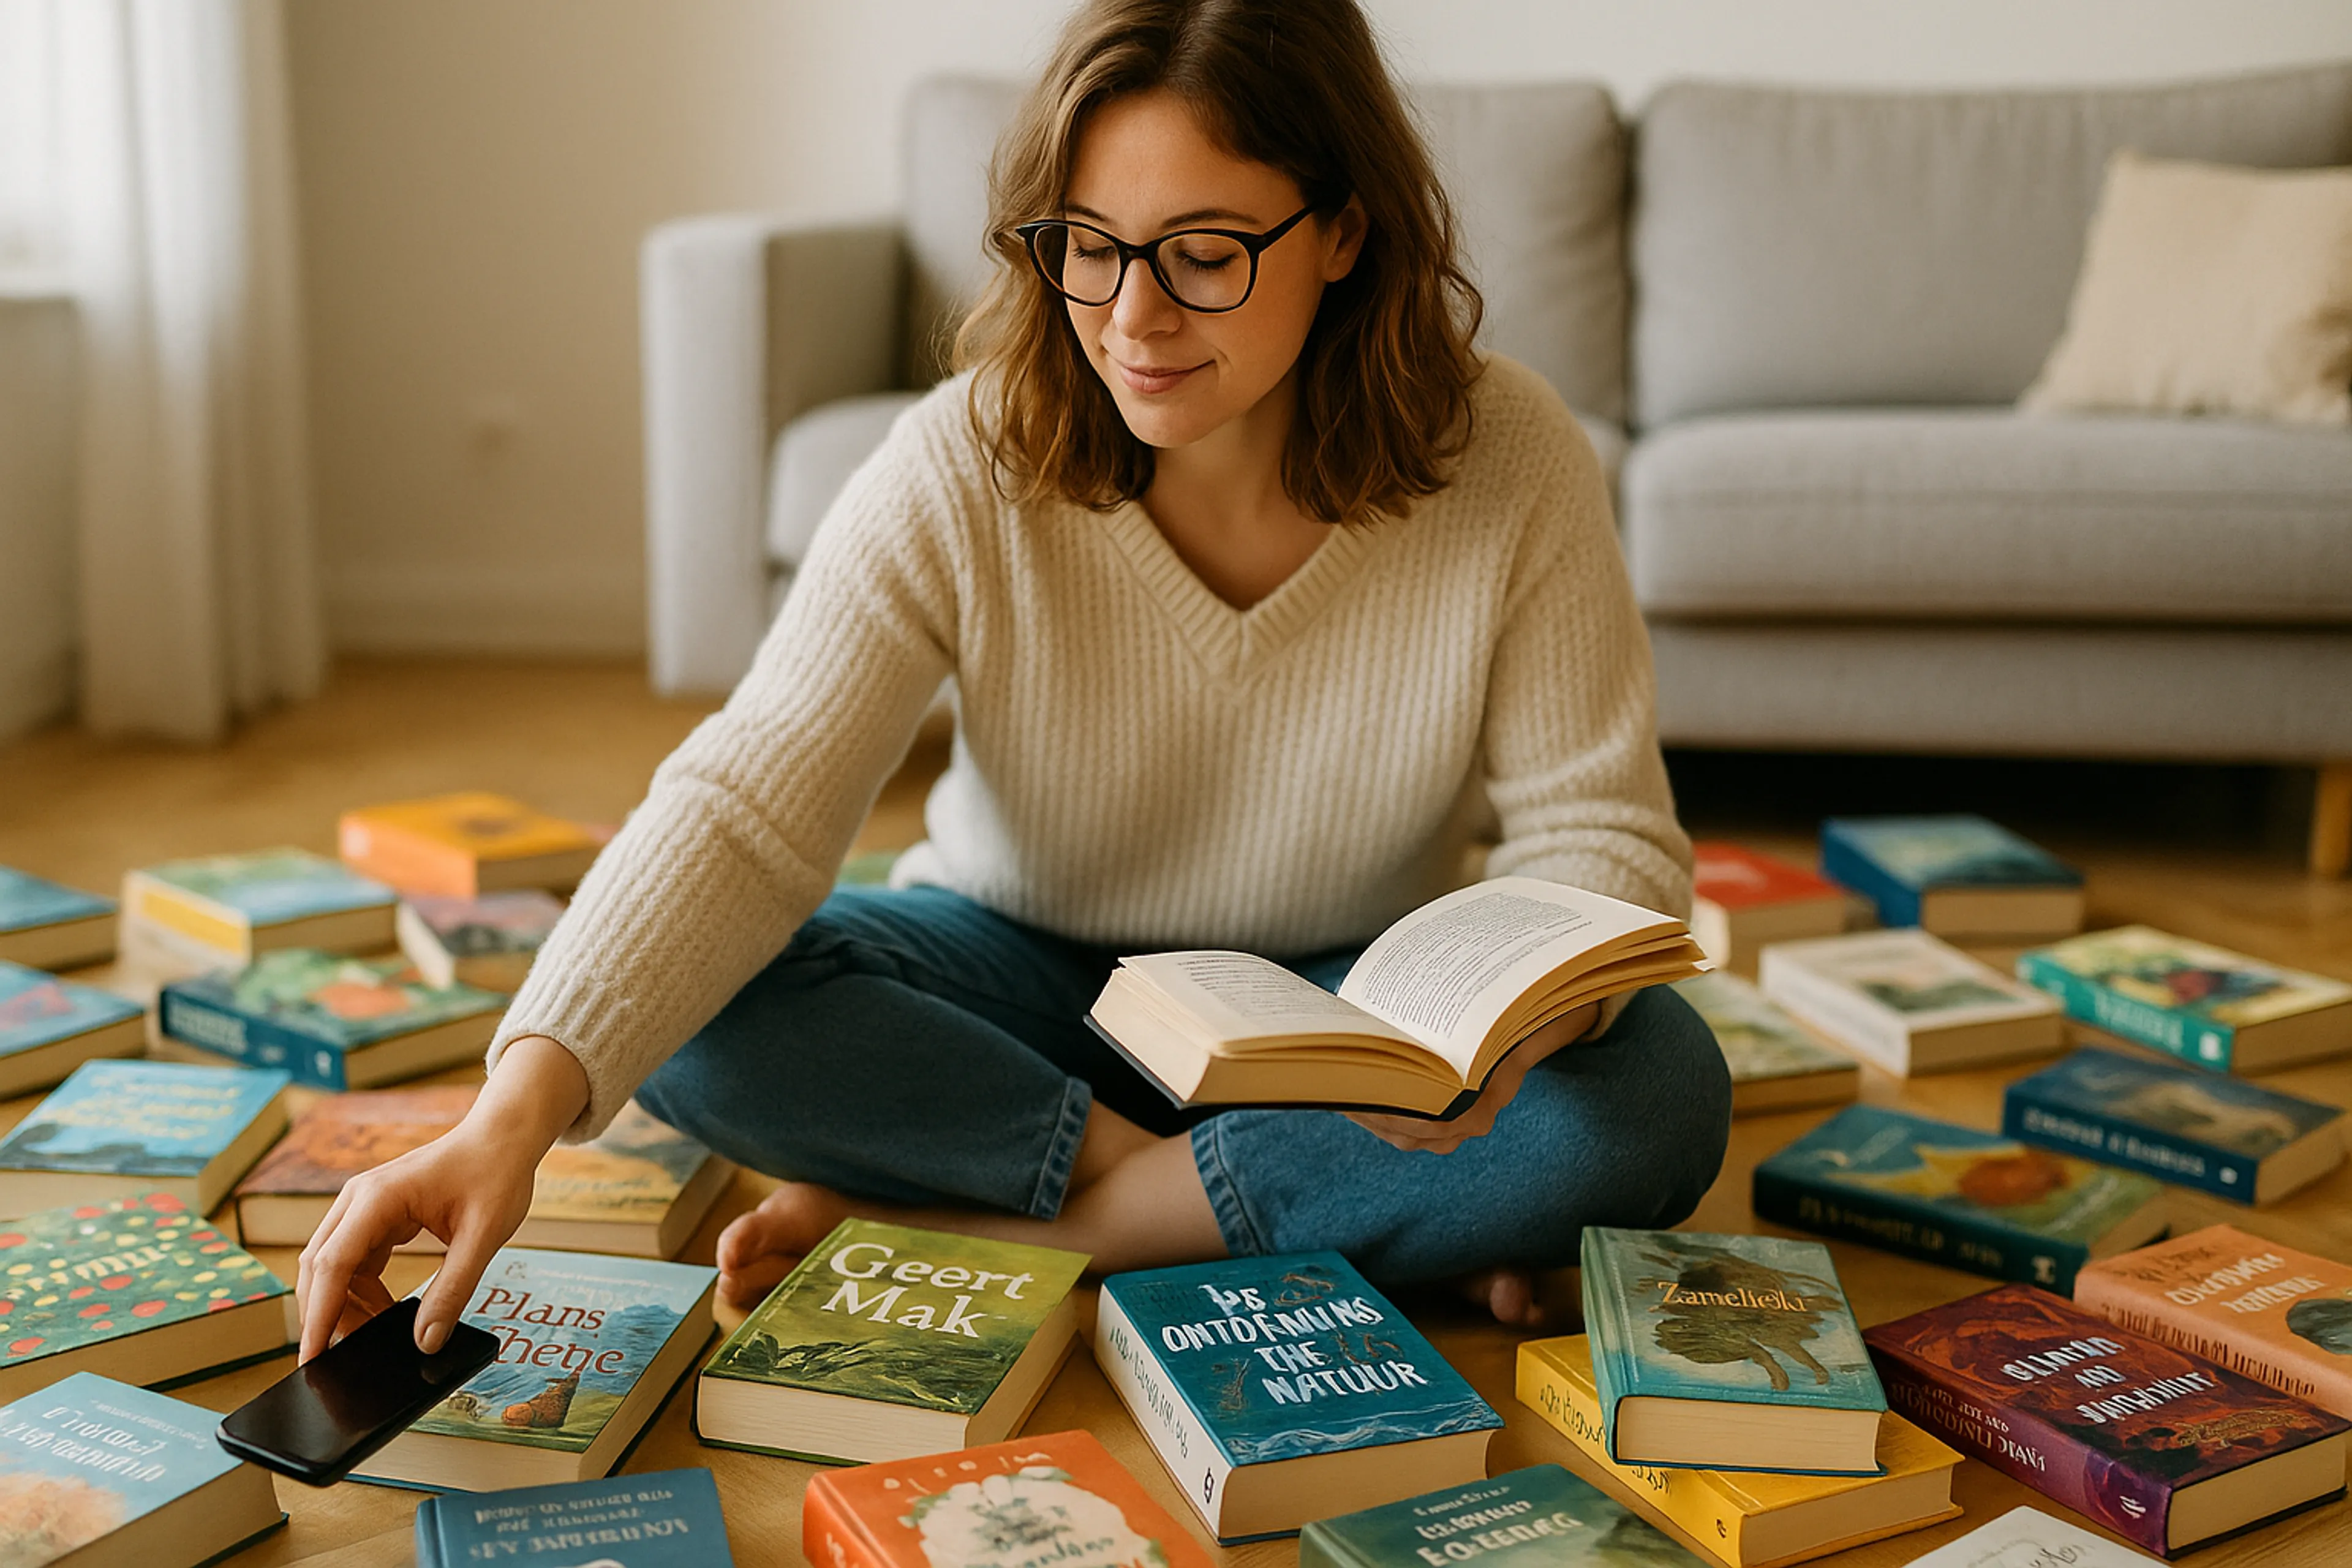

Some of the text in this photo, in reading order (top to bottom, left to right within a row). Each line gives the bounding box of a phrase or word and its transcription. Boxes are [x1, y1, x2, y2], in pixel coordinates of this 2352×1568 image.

[830, 1243, 1034, 1299] Geert
[474, 1285, 606, 1330] Plans
[821, 1280, 988, 1338] Mak
[1262, 1360, 1428, 1405] NATUUR
